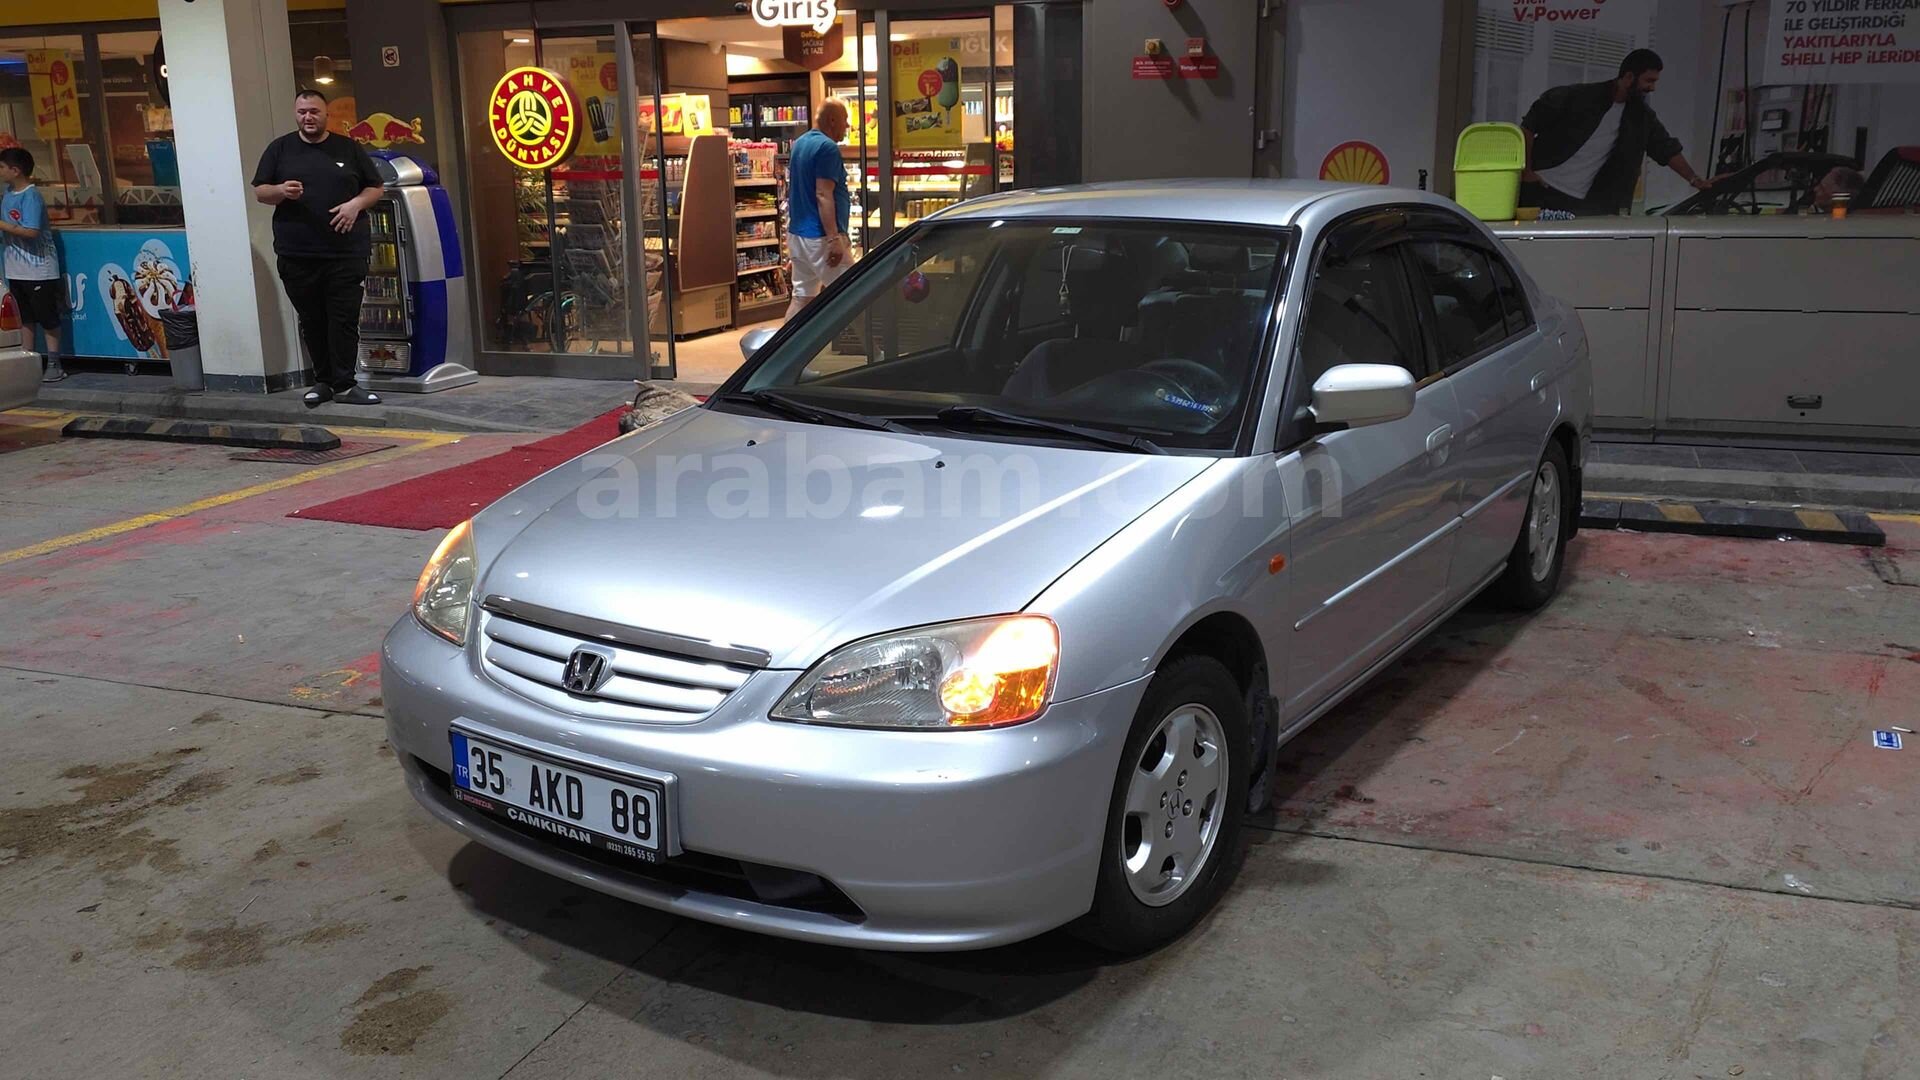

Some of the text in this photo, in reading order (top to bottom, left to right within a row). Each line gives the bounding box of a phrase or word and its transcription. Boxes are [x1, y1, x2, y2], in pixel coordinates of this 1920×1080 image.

[756, 0, 829, 27] Giriş
[1513, 6, 1600, 22] V-Power
[1786, 1, 1807, 14] 70
[1812, 0, 1860, 12] YILDIR
[1784, 33, 1896, 49] YAKITLARIYLA
[892, 42, 920, 57] Deli
[28, 53, 46, 64] Deli
[570, 57, 594, 69] Deli
[1782, 52, 1826, 66] SHELL
[1831, 51, 1862, 65] HEP
[496, 74, 563, 109] KAHVE
[496, 128, 565, 162] DÜNYASI
[456, 764, 469, 779] TR
[470, 746, 650, 841] 35 AKD 88
